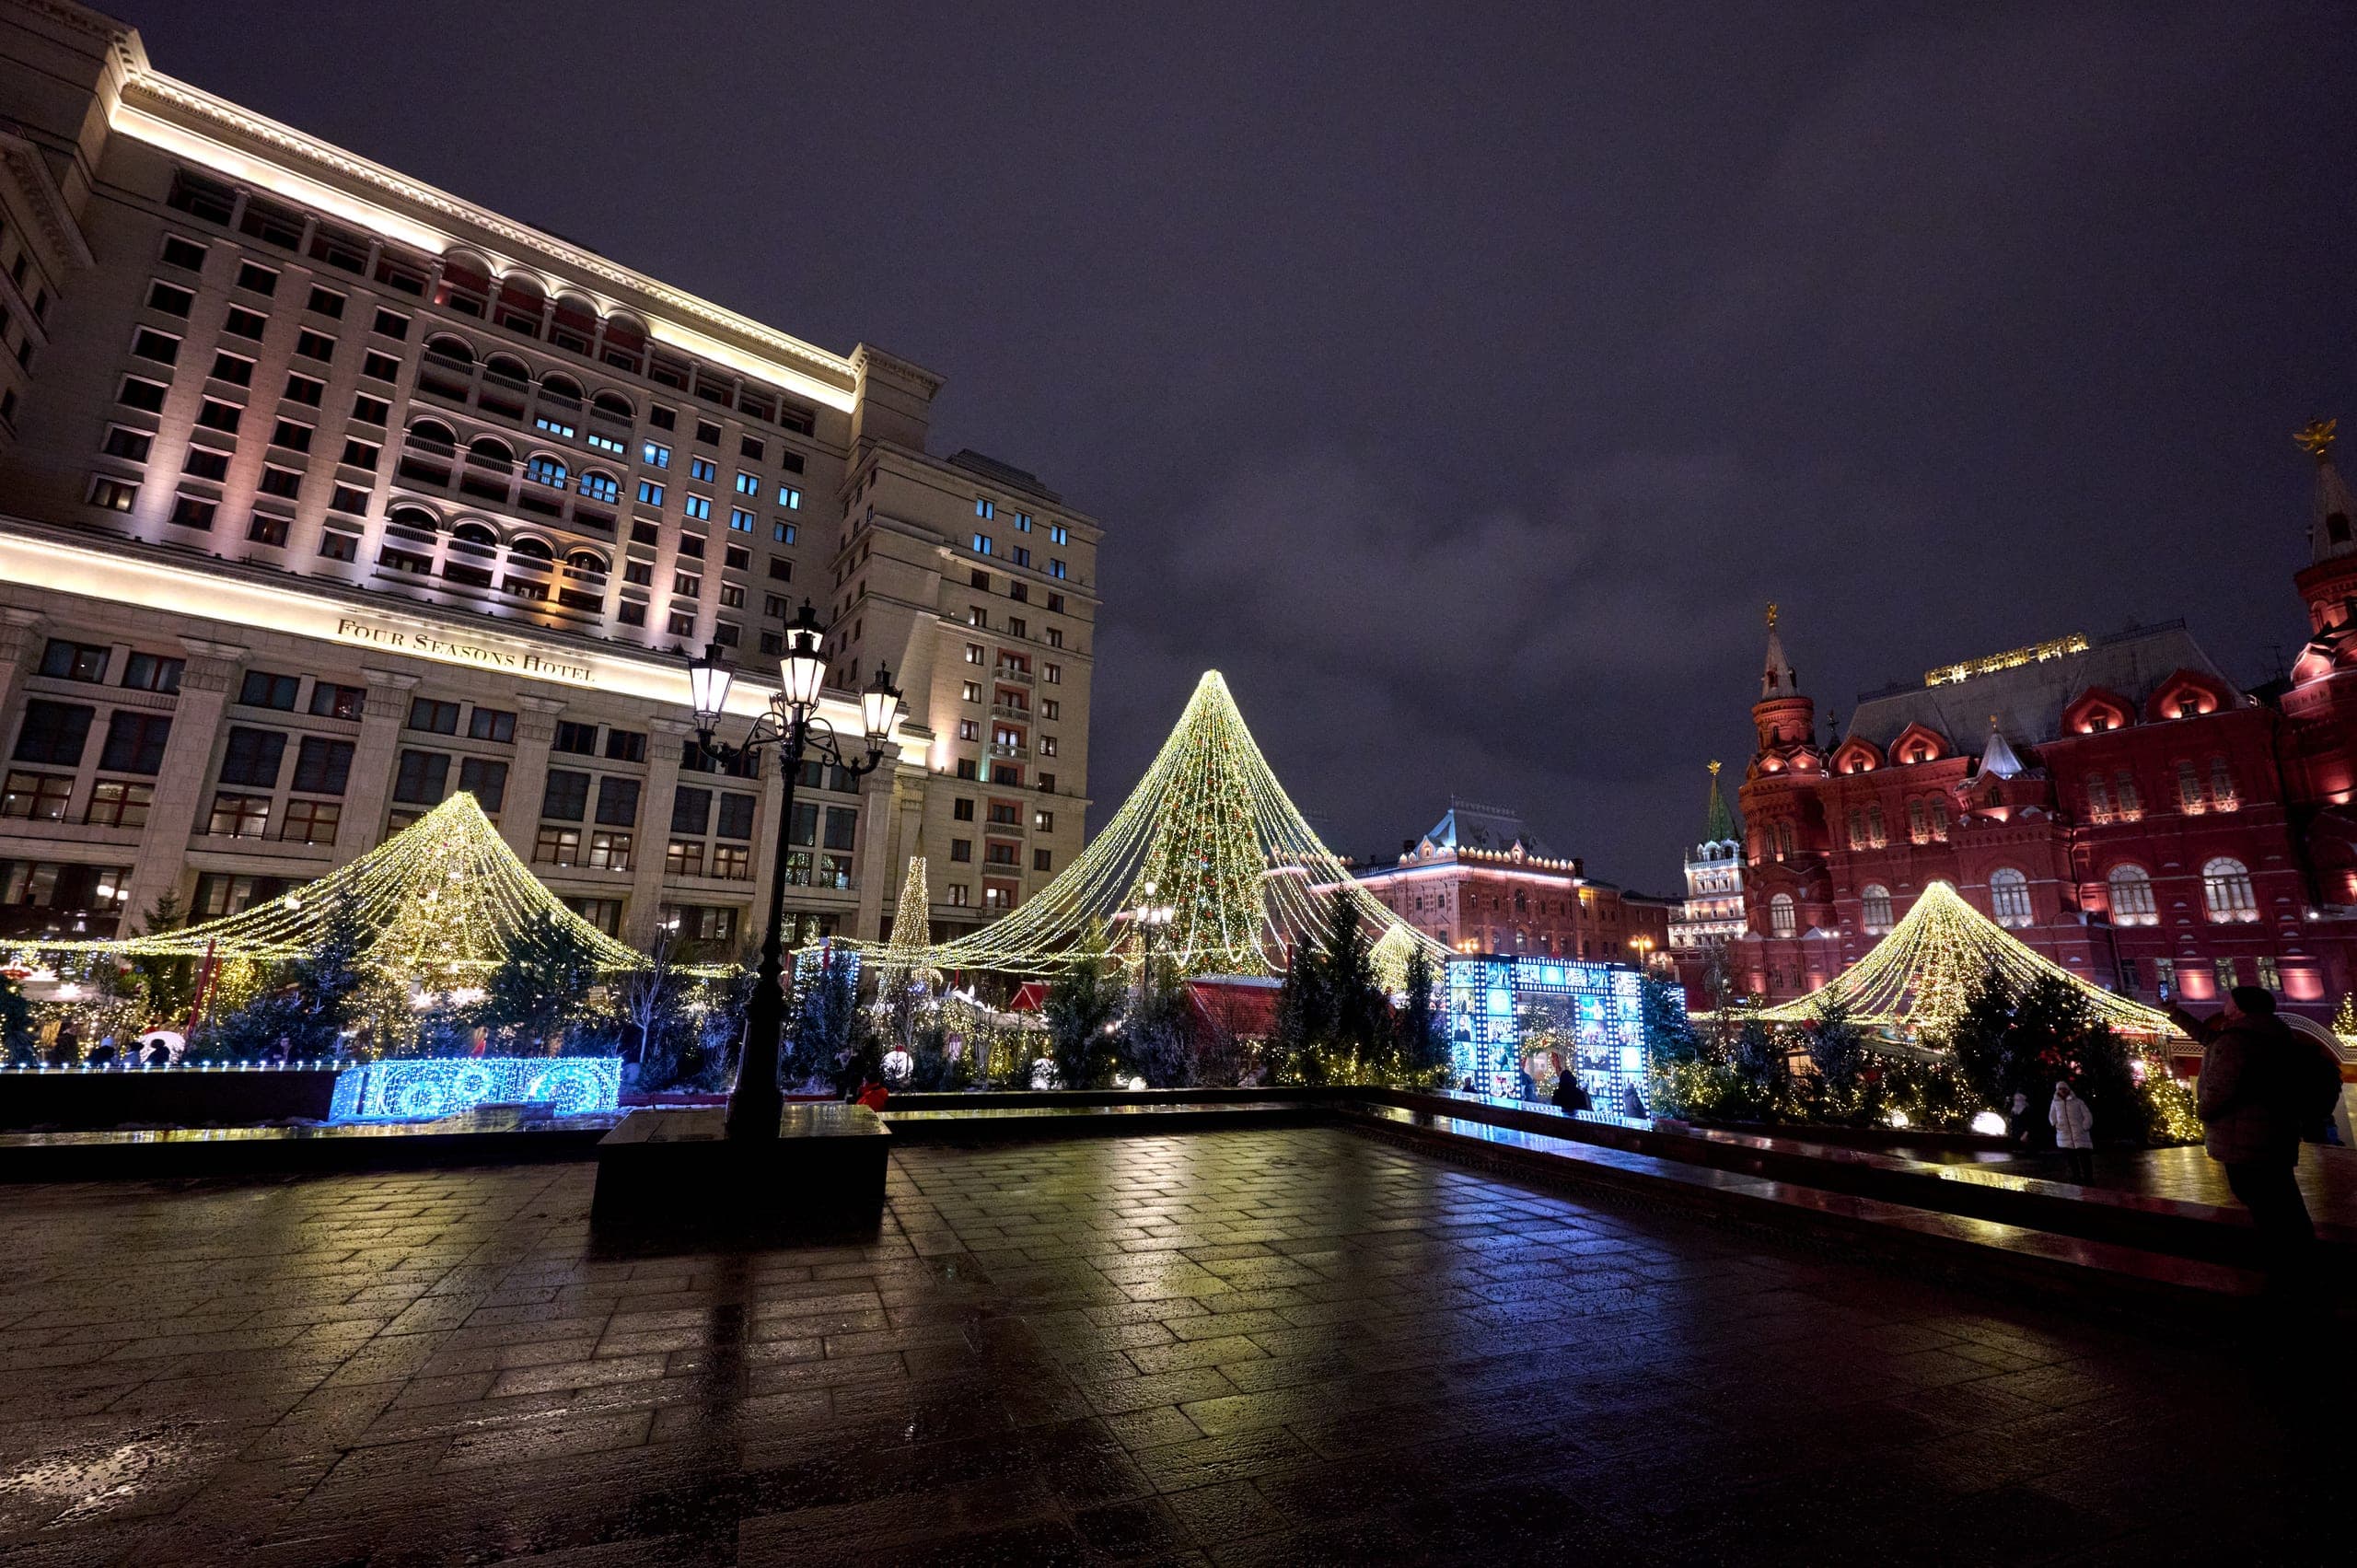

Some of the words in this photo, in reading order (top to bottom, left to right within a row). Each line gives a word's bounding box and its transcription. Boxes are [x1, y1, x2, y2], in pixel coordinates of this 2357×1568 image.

[338, 619, 404, 645] FOUR
[413, 633, 516, 666] SEASONS
[523, 654, 595, 681] HOTEL
